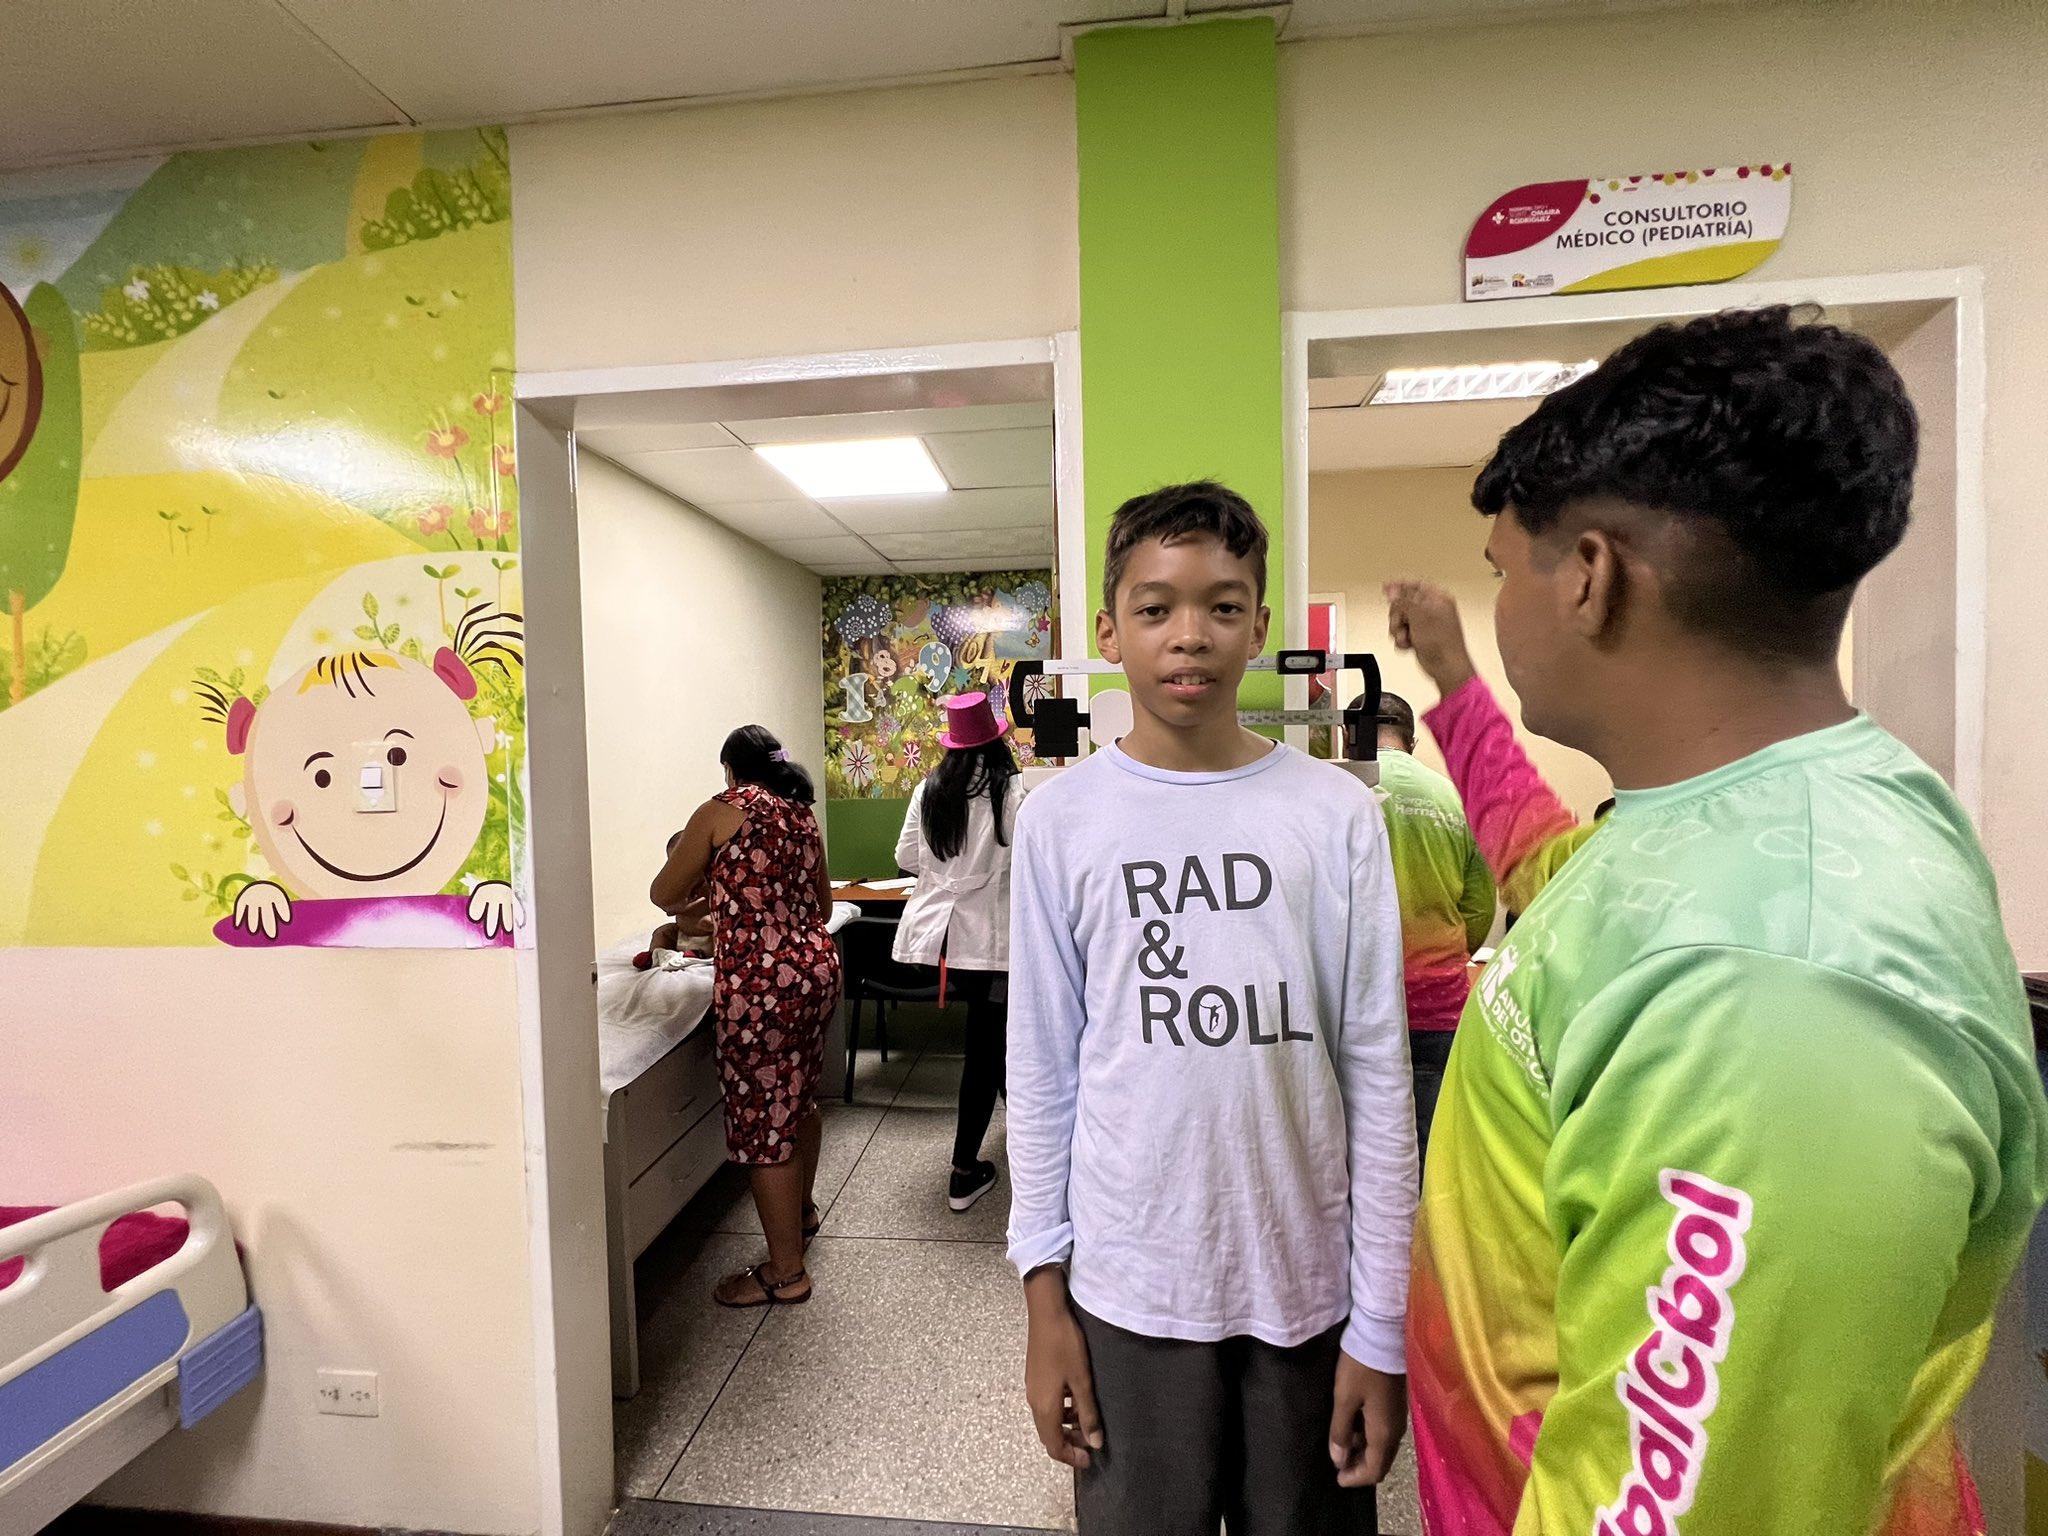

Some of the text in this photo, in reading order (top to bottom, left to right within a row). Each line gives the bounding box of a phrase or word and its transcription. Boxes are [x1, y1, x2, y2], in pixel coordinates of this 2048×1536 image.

[1556, 217, 1753, 250] MÉDICO (PEDIATRÍA)
[1603, 200, 1748, 227] CONSULTORIO
[1121, 852, 1273, 918] RAD
[1137, 919, 1188, 980] &
[1139, 981, 1314, 1048] ROLL
